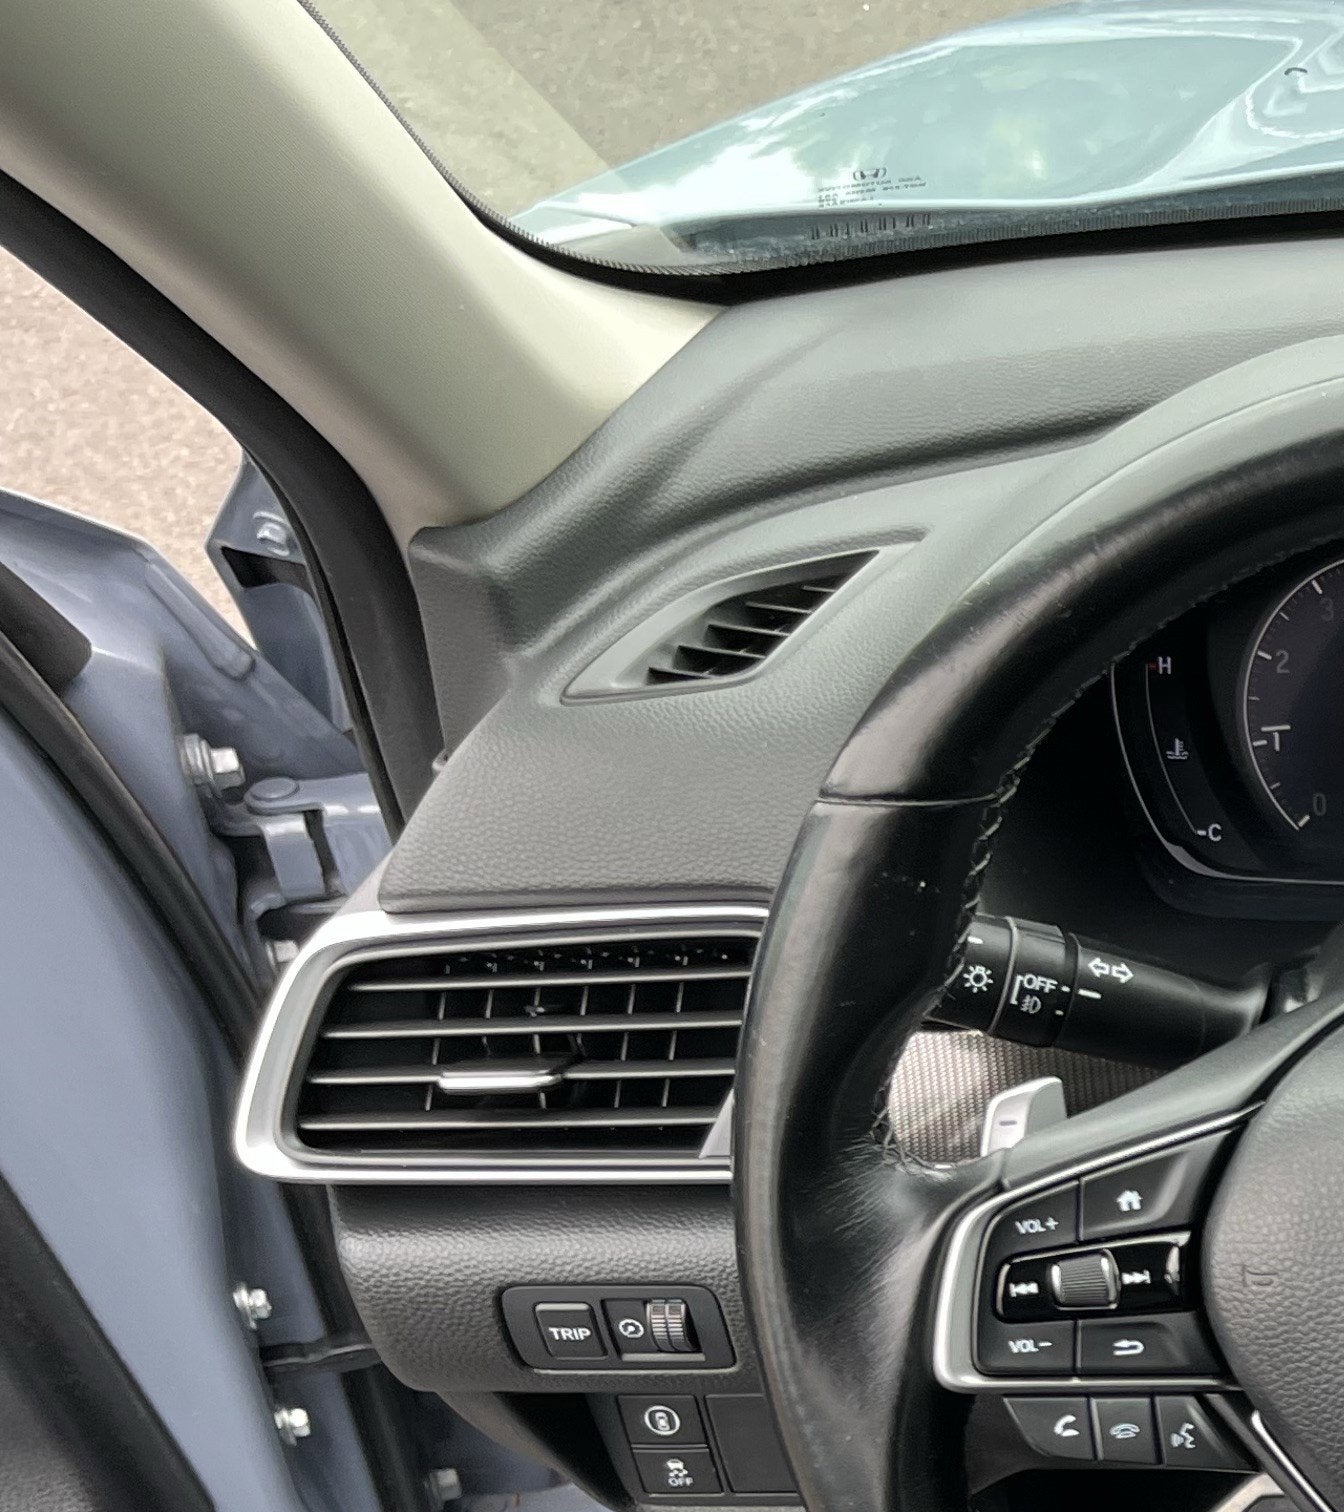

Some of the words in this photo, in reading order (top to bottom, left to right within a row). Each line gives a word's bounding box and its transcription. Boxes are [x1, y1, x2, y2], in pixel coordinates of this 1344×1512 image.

[1157, 656, 1172, 675] H
[1276, 650, 1290, 674] 2
[1208, 823, 1222, 842] C
[1022, 973, 1057, 993] OFF
[1016, 1215, 1059, 1235] VOL+
[549, 1324, 591, 1343] TRIP
[669, 1475, 694, 1487] OFF
